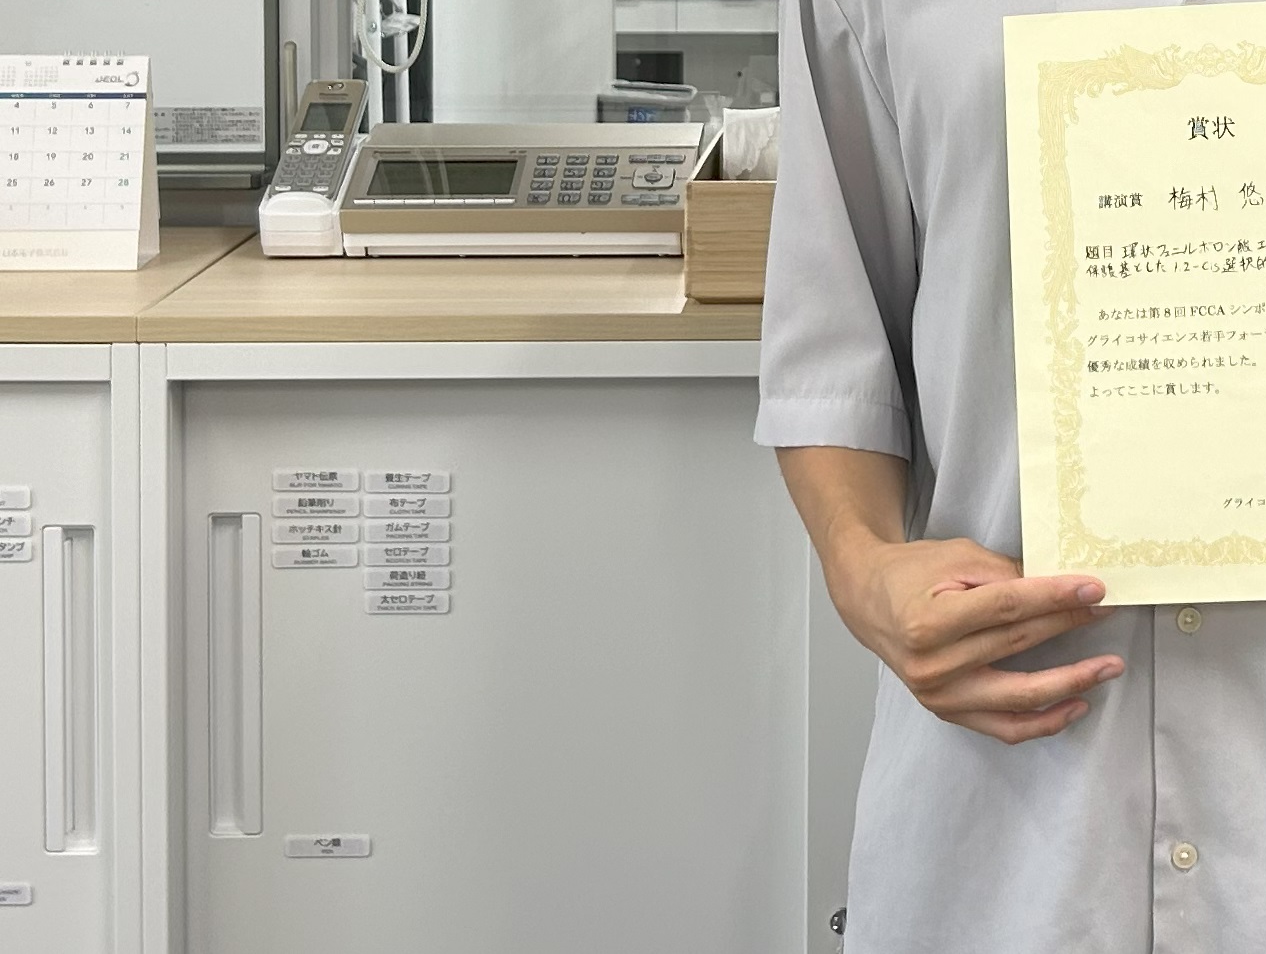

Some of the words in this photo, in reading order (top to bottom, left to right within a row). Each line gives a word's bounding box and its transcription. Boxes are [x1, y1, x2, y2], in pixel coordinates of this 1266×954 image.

[52, 102, 56, 110] 5
[126, 102, 130, 110] 7
[10, 127, 20, 135] 11
[48, 127, 58, 135] 12
[84, 127, 95, 135] 13
[122, 127, 132, 135] 14
[1187, 116, 1236, 140] 賞状
[9, 153, 19, 161] 18
[46, 153, 56, 161] 19
[82, 152, 94, 161] 20
[120, 152, 130, 161] 21
[6, 179, 18, 187] 25
[44, 179, 55, 187] 26
[81, 178, 92, 187] 27
[118, 178, 130, 186] 28
[1098, 192, 1143, 208] 講演賞
[1168, 185, 1219, 211] 梅村
[1086, 245, 1113, 260] 題目
[1088, 354, 1257, 373] 優秀な成績を収められました。
[1090, 382, 1220, 398] よってここに賞します。
[390, 498, 426, 508] 布テープ
[288, 524, 342, 534] ホッチキス針
[385, 522, 430, 532] ガムテープ
[384, 546, 429, 556] セロテープ
[380, 594, 434, 604] 太セロテープ
